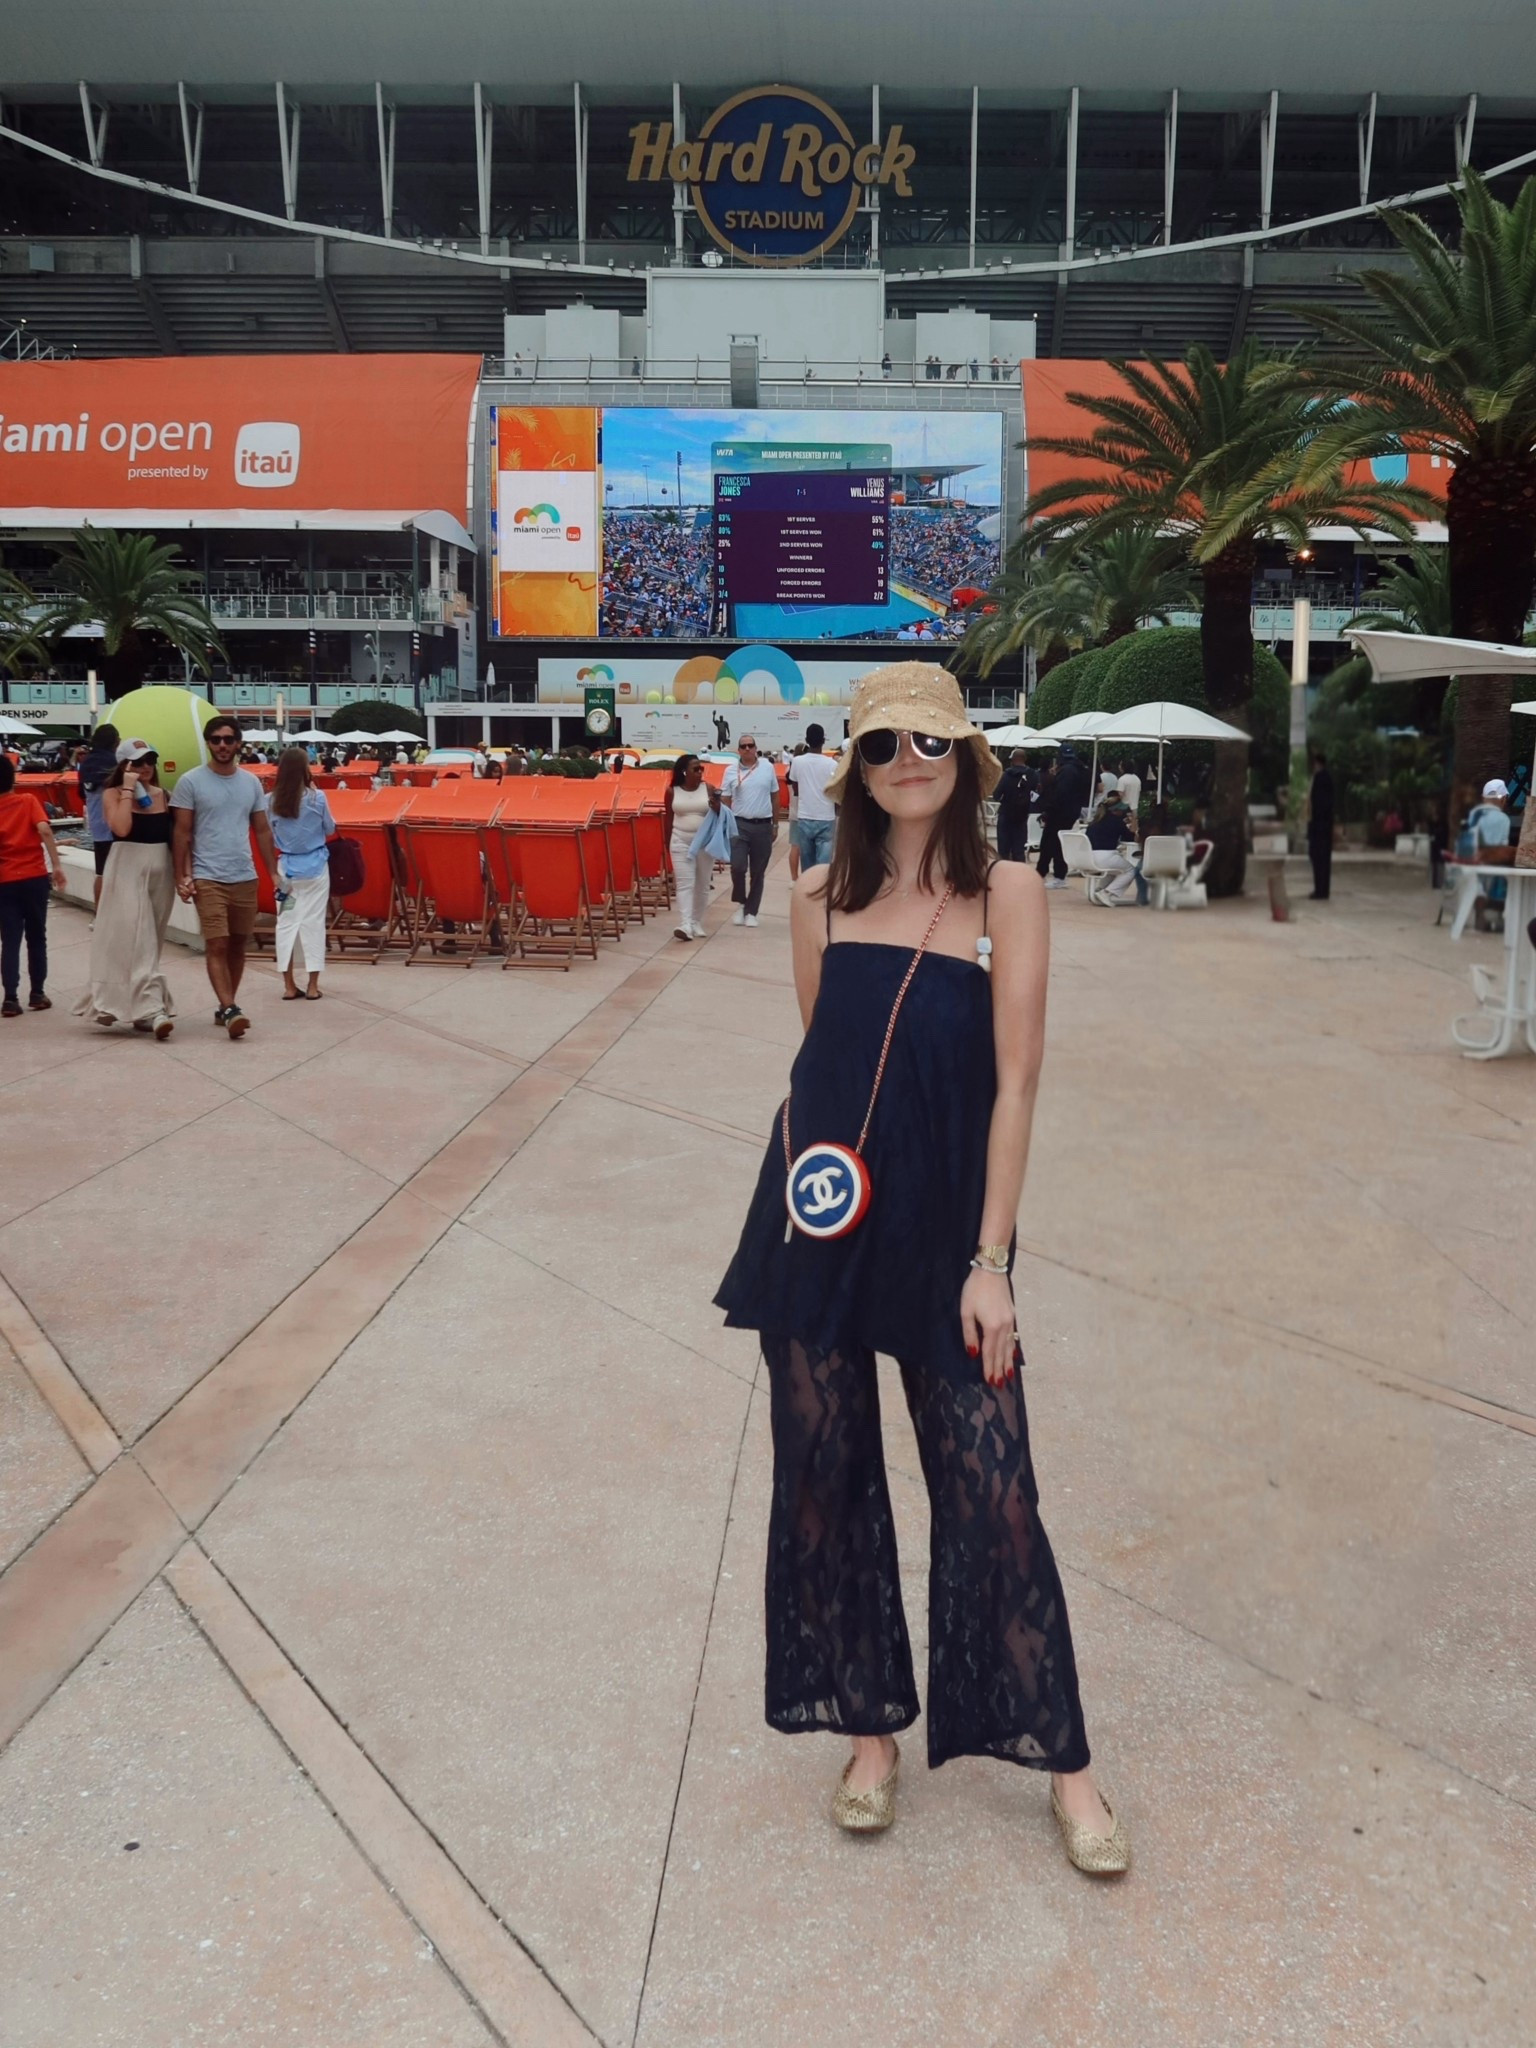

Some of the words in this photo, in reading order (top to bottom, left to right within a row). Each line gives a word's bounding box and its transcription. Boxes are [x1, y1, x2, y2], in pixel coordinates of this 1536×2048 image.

[627, 122, 773, 183] Hard
[780, 124, 916, 196] Rock
[725, 210, 824, 230] STADIUM
[100, 421, 213, 462] open
[779, 451, 792, 459] OPEN
[793, 451, 821, 459] PRESENTED
[822, 451, 829, 459] BY
[240, 450, 292, 474] itaú
[128, 465, 189, 480] presented
[193, 465, 208, 480] by
[718, 476, 751, 487] FRANCESCA
[866, 478, 885, 488] VENUS
[719, 486, 741, 496] JONES
[850, 487, 885, 498] WILLIAMS
[874, 592, 883, 600] 2/2
[0, 710, 20, 718] PEN
[22, 710, 48, 719] SHOP
